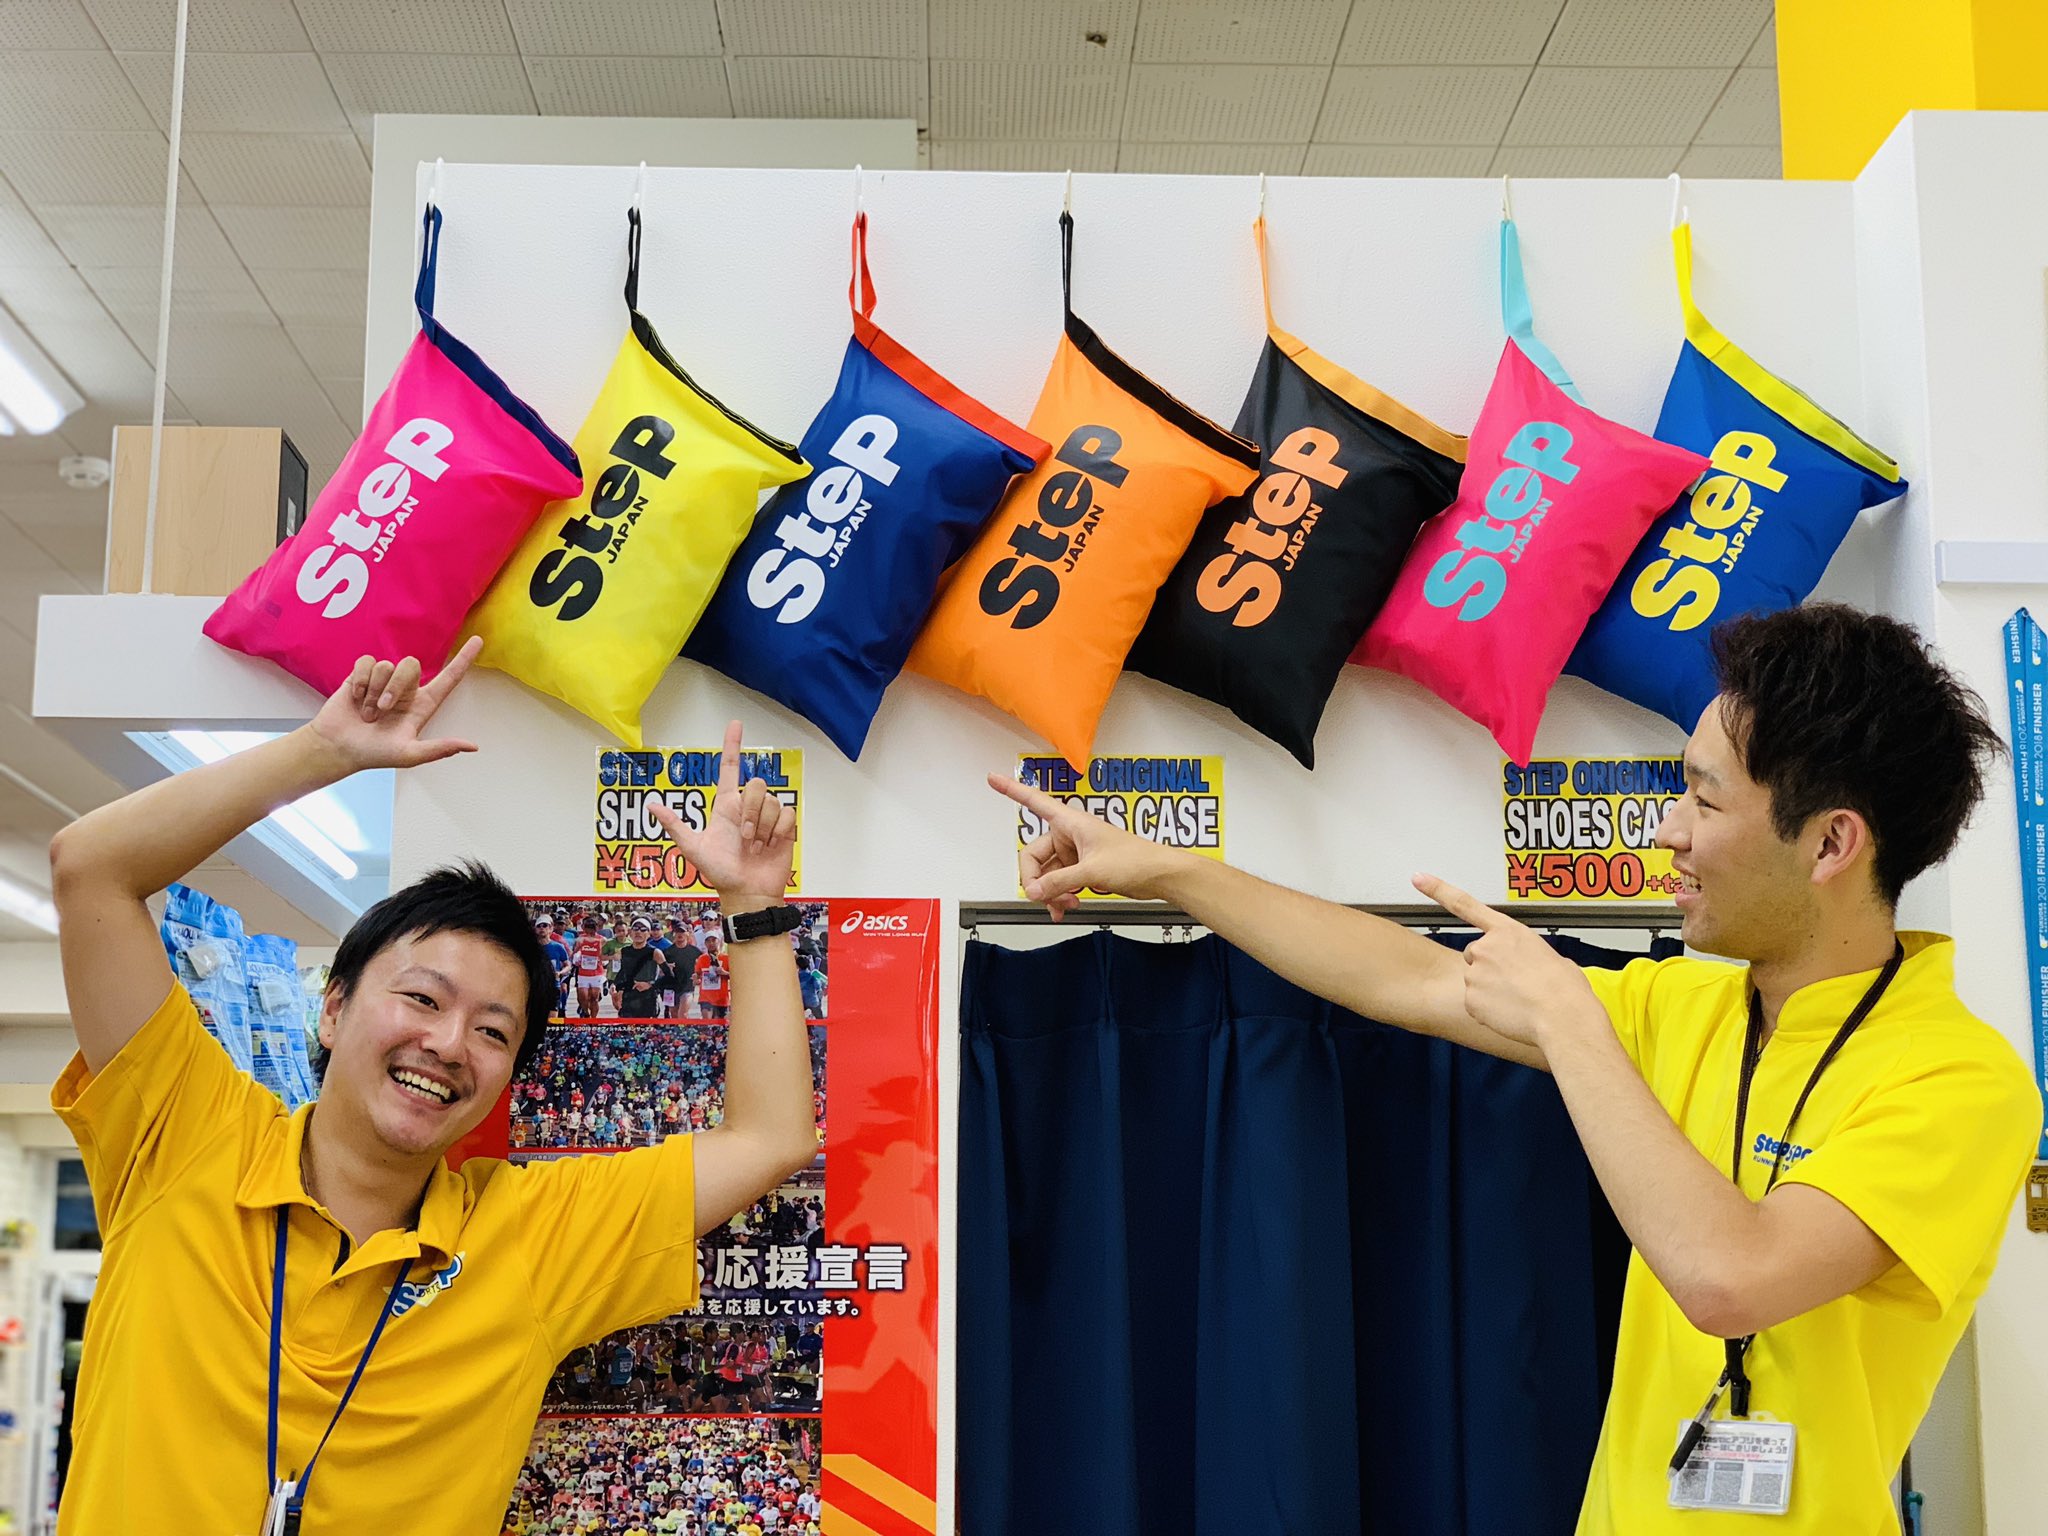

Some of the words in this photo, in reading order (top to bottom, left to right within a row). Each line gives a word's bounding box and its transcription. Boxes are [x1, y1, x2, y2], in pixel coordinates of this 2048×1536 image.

[296, 417, 454, 619] Step
[373, 495, 419, 563] JAPAN
[529, 415, 677, 621] Step
[606, 496, 649, 564] JAPAN
[747, 414, 901, 624] Step
[829, 498, 872, 568] JAPAN
[978, 424, 1130, 630] Step
[1063, 504, 1105, 573] JAPAN
[1196, 426, 1349, 628] Step
[1282, 502, 1323, 572] JAPAN
[1423, 421, 1581, 622] Step
[1509, 497, 1553, 564] JAPAN
[1630, 430, 1789, 632] Step
[1721, 505, 1764, 574] JAPAN
[2033, 683, 2043, 734] FINISHER
[599, 751, 664, 787] STEP
[668, 751, 789, 787] ORINAL
[1019, 757, 1084, 792] STEP
[1089, 758, 1209, 793] ORIGINAL
[1504, 761, 1568, 796] STEP
[1572, 760, 1688, 796] ORIGINAL
[2034, 735, 2043, 759] 2018
[1133, 795, 1220, 848] CASE
[1504, 797, 1614, 850] SHOES
[1618, 797, 1680, 850] CA
[2036, 824, 2046, 875] FINISHER
[1506, 852, 1645, 898] ¥500
[2037, 877, 2046, 900] 2018
[863, 915, 908, 931] asics
[674, 1298, 860, 1317] 様を応援しています。
